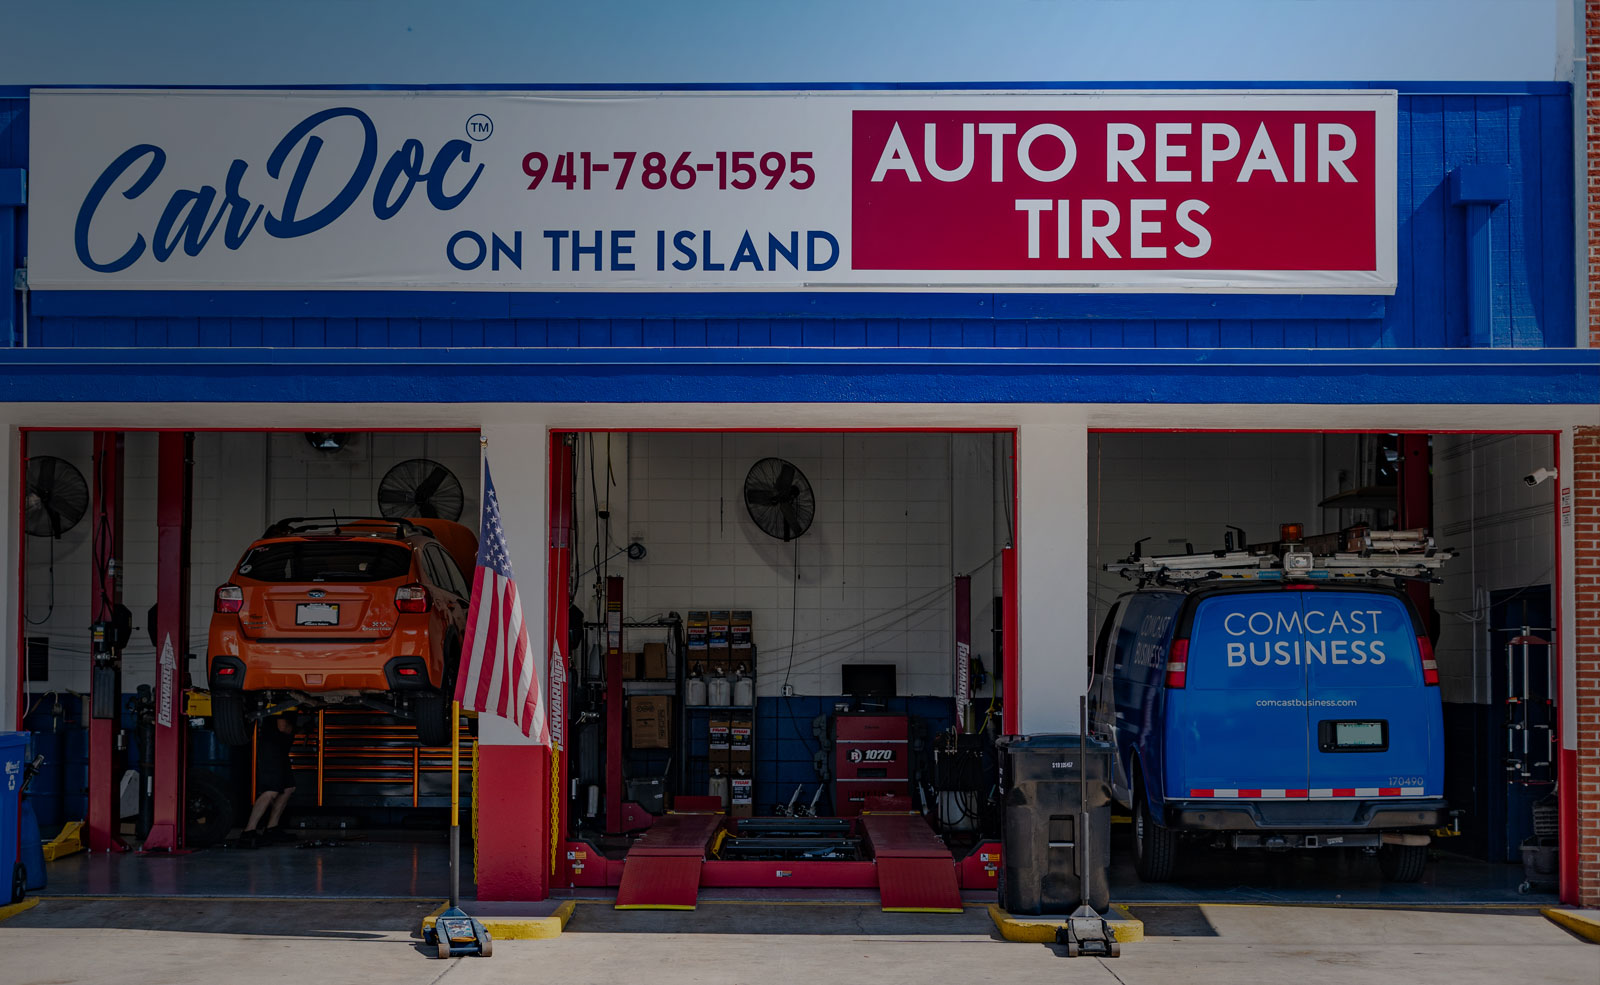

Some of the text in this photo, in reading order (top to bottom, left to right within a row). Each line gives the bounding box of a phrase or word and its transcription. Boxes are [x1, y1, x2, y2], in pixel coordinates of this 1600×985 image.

[470, 122, 489, 133] TM
[870, 122, 1358, 184] AUTO REPAIR
[521, 151, 816, 191] 941-786-1595
[74, 107, 485, 273] CarDoc
[1014, 198, 1213, 260] TIRES
[446, 229, 841, 272] ON THE ISLAND
[1223, 609, 1384, 637] COMCAST
[1226, 640, 1387, 668] BUSINESS
[1255, 698, 1358, 708] comcastbusiness.com
[864, 749, 893, 761] 1070
[1388, 776, 1424, 786] 170490
